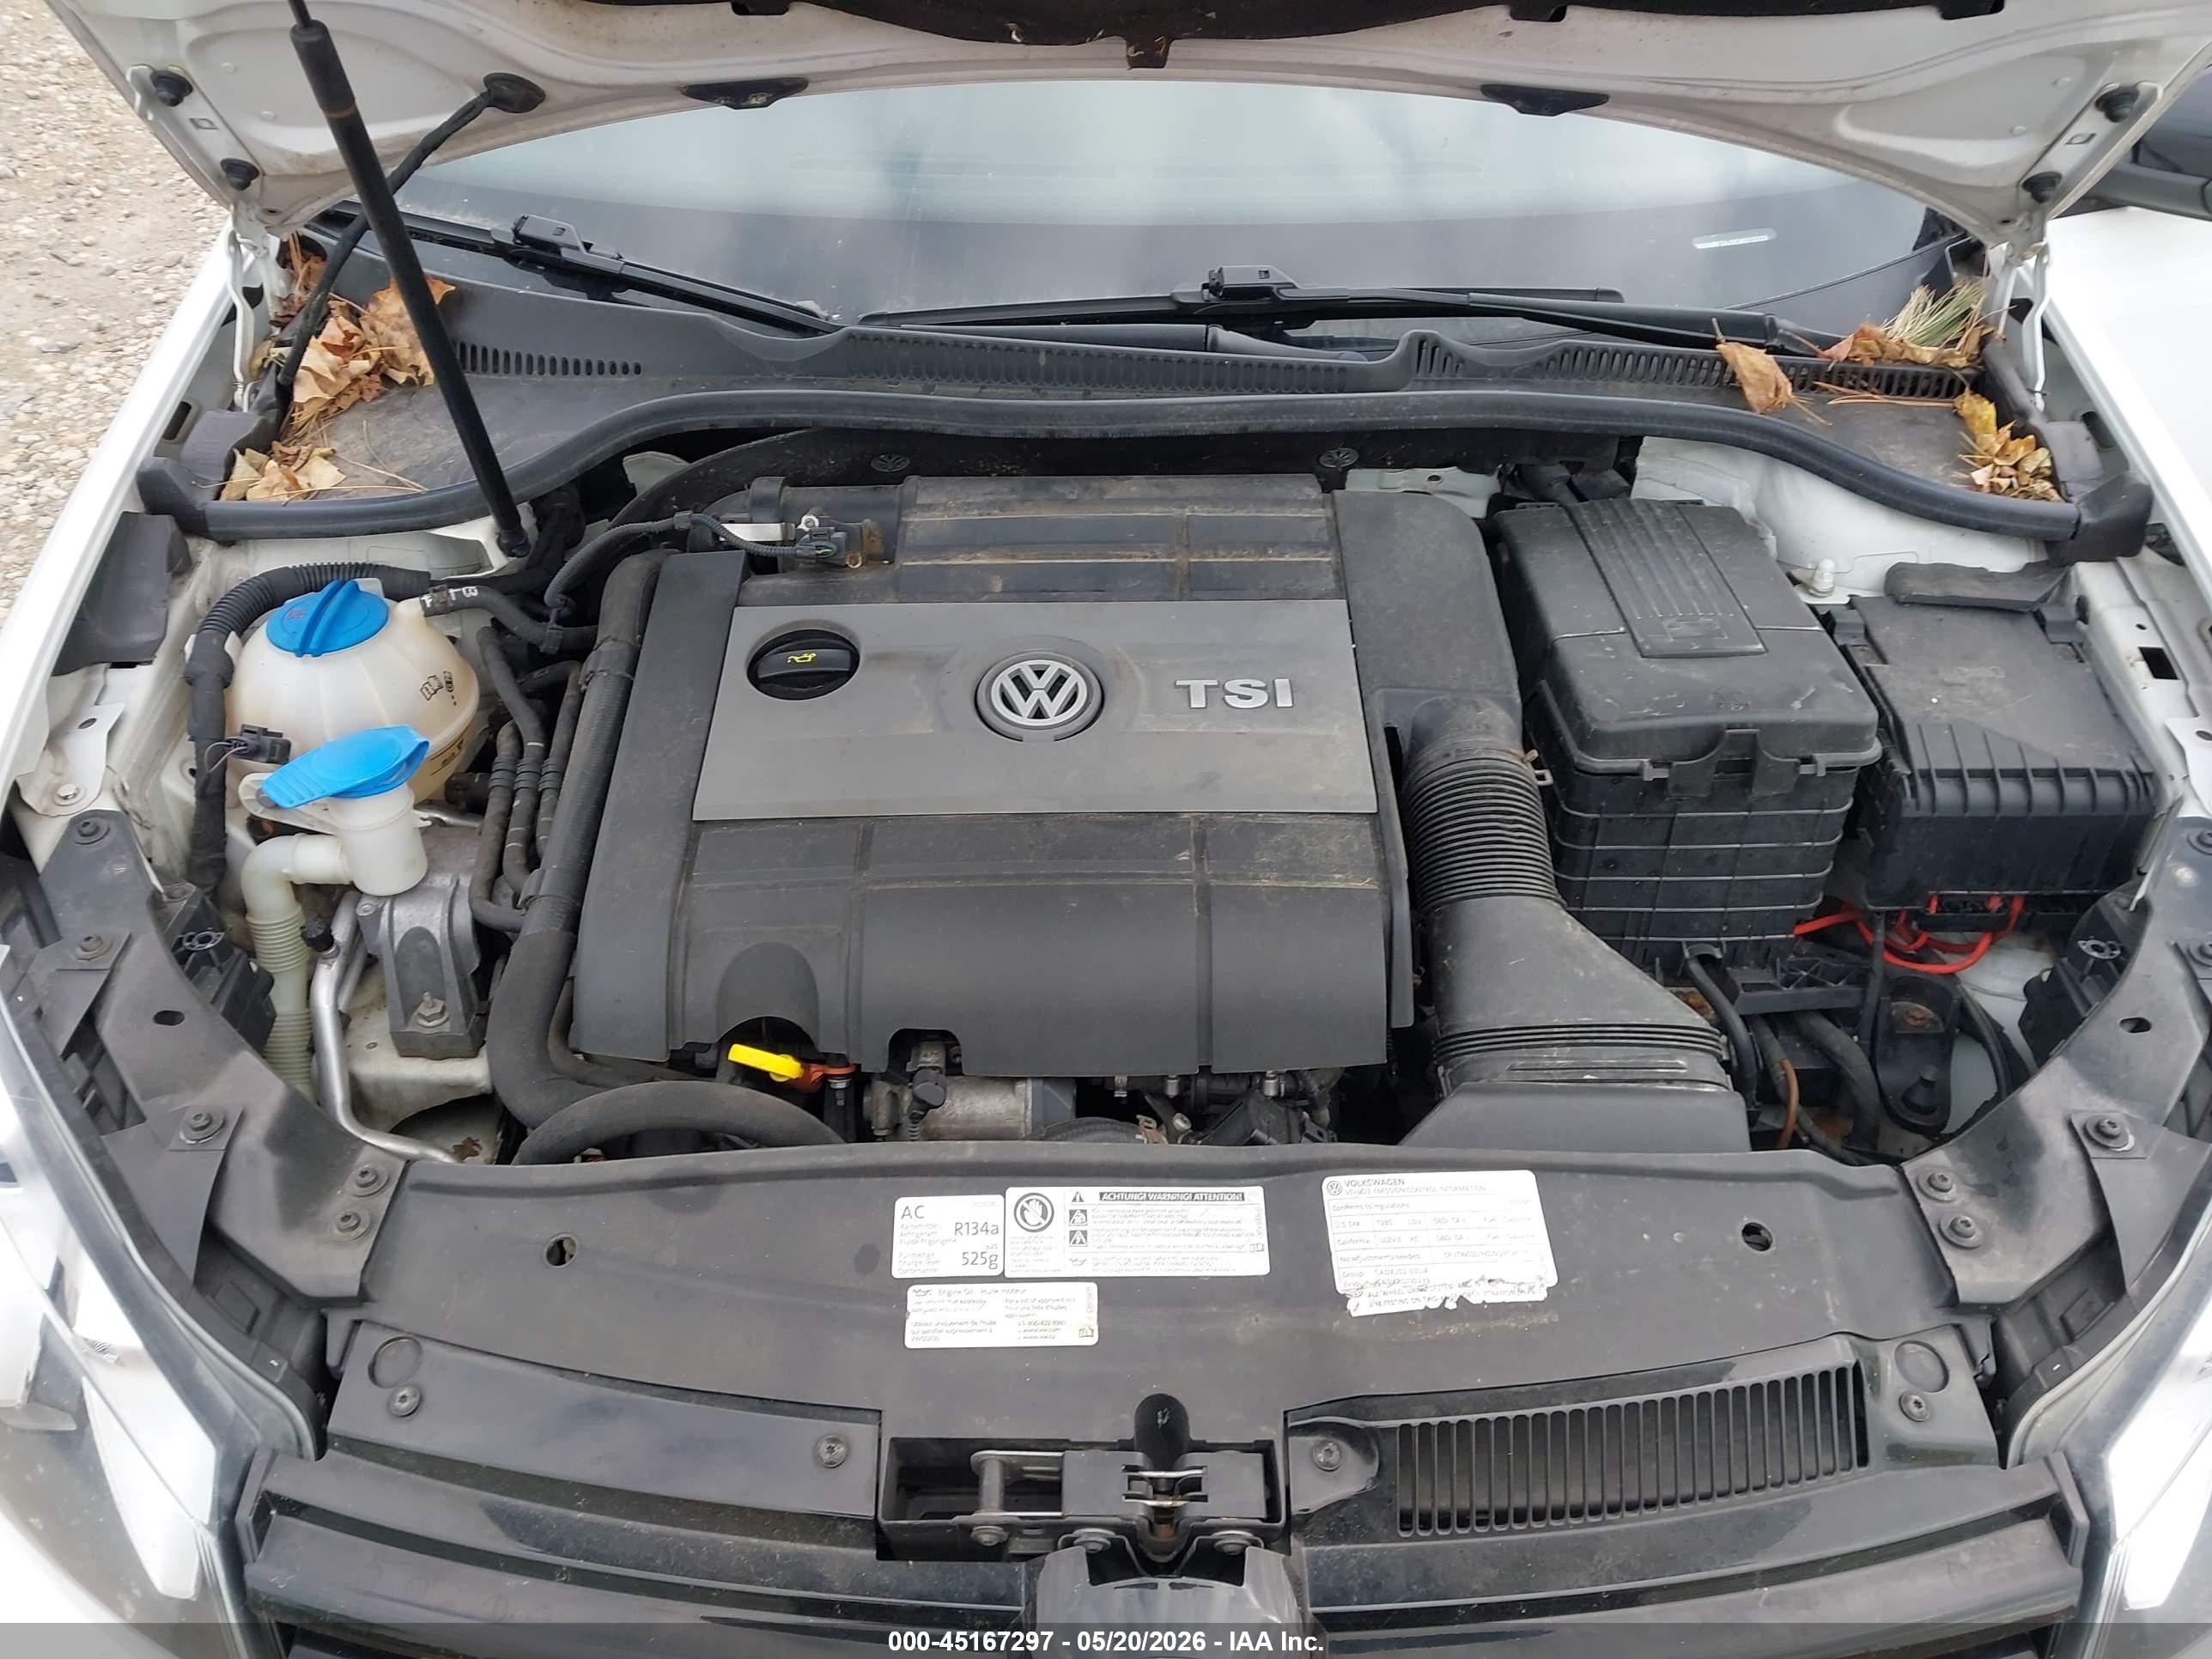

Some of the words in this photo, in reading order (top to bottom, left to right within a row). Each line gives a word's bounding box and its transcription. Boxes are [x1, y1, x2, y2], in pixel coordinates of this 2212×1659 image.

[990, 659, 1088, 726] VW
[1176, 678, 1294, 709] TSI
[1344, 1178, 1406, 1188] VOLKSWAGEN
[900, 1205, 926, 1220] AC
[954, 1221, 1000, 1237] R134a
[962, 1251, 1000, 1270] 525g
